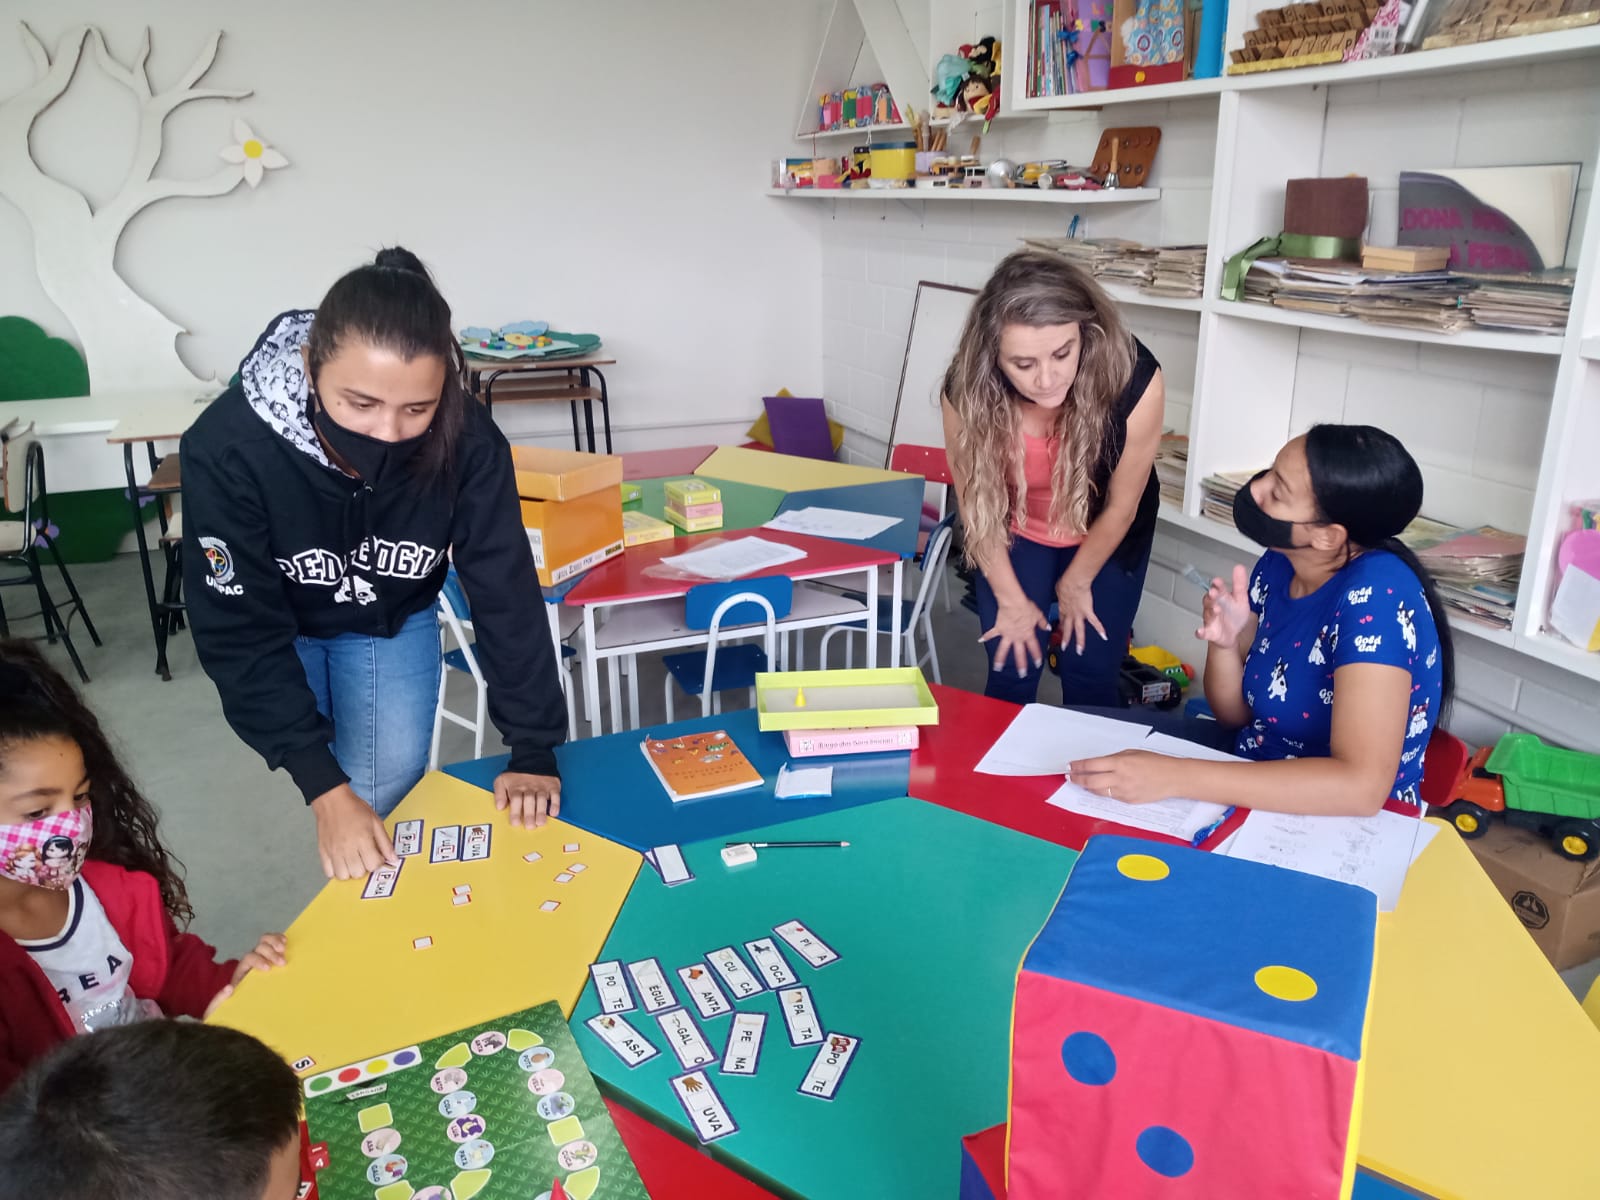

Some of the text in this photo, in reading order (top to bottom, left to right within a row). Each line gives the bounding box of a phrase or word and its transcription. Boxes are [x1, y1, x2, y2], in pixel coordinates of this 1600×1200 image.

[724, 961, 753, 994] CU CA
[769, 965, 786, 983] OCA
[605, 975, 624, 1009] PO TE
[702, 992, 721, 1013] ANTA
[793, 1004, 813, 1040] PA TA
[622, 1039, 645, 1057] ASA
[734, 1030, 753, 1070] PE NA
[811, 1051, 840, 1093] PO TE
[702, 1107, 723, 1132] UVA
